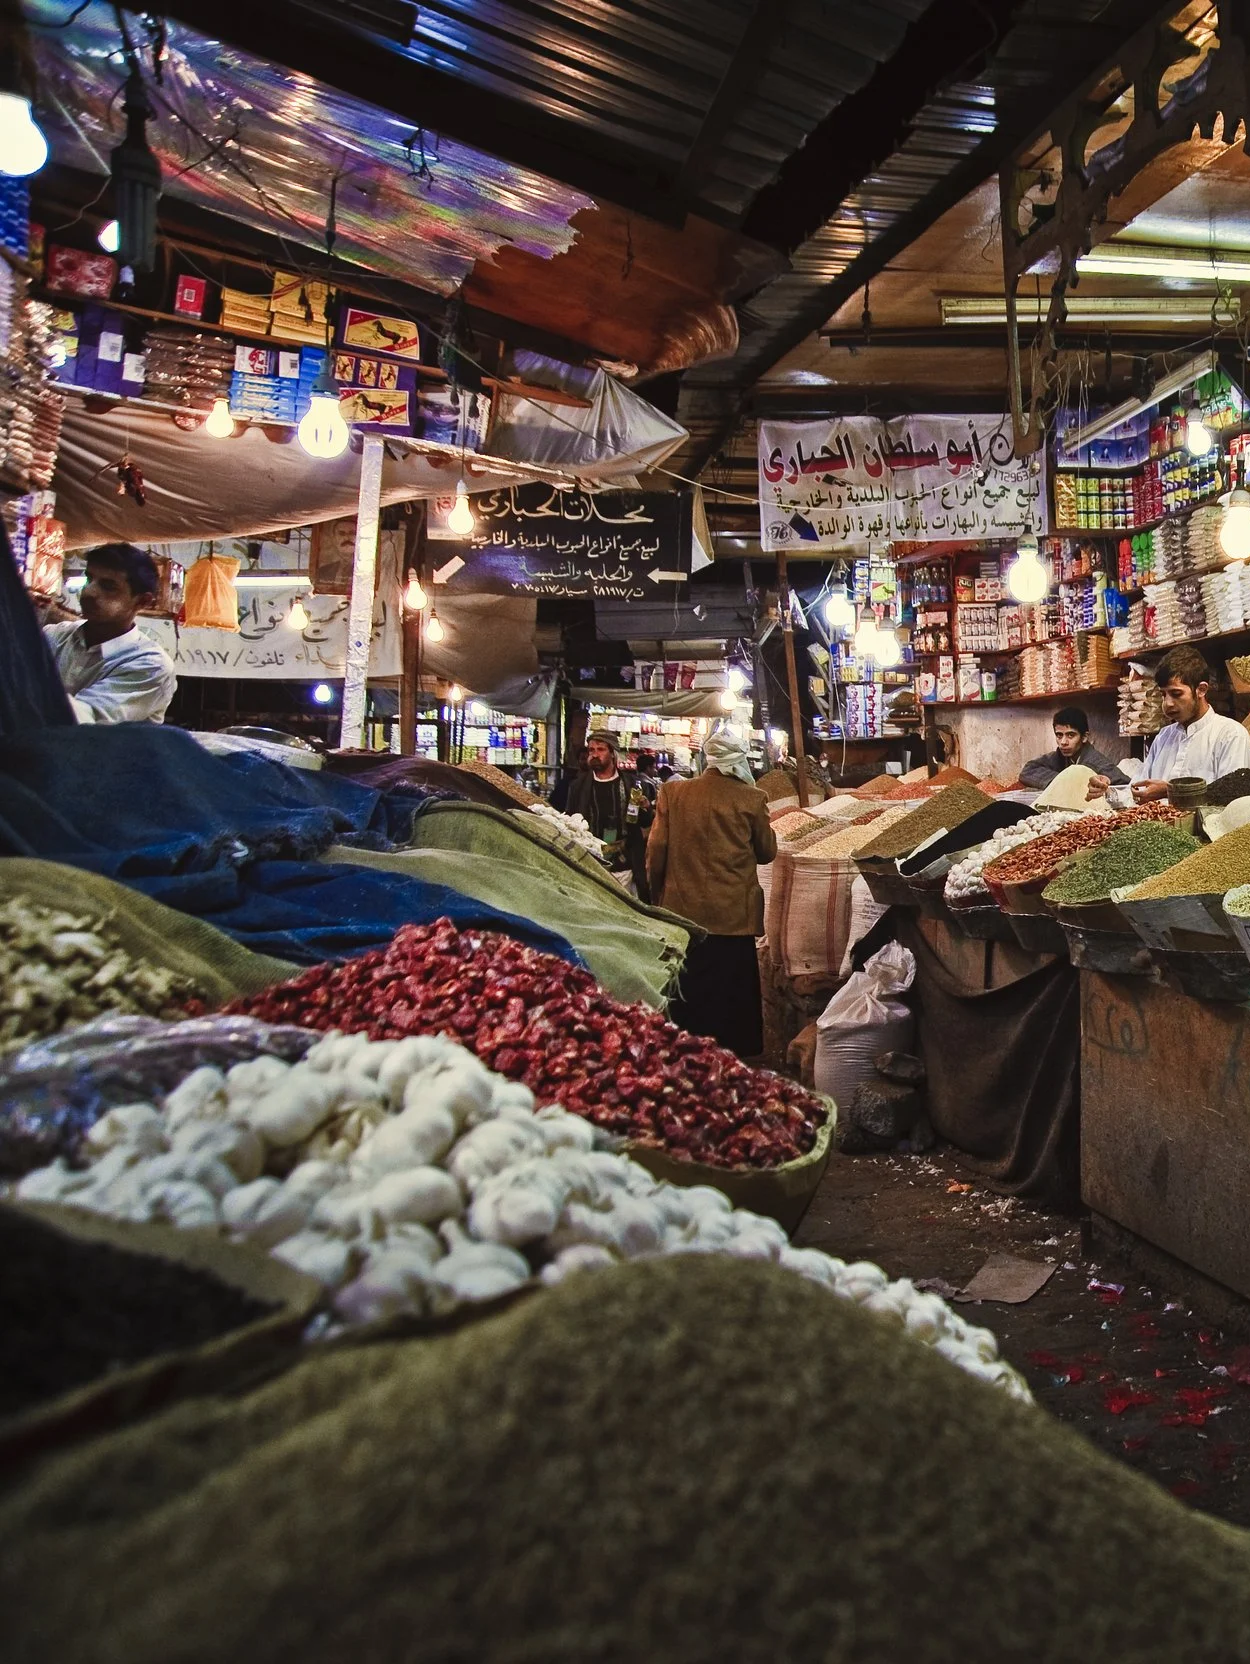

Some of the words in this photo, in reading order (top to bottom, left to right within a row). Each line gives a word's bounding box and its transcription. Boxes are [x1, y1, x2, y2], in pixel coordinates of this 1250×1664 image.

[863, 431, 940, 479] سلطان
[947, 420, 983, 476] أبو
[477, 486, 563, 522] الحباري
[847, 484, 890, 506] البلدية
[941, 480, 978, 510] أنواع
[983, 485, 1011, 508] جميع
[1016, 480, 1041, 508] لبيع
[564, 493, 655, 524] محلات
[818, 515, 856, 540] الوالدة
[858, 514, 891, 539] وقهوة
[895, 510, 928, 536] بأنواعها
[932, 511, 988, 535] والبهارات
[518, 531, 556, 549] البلدية
[556, 534, 590, 554] الحبوب
[619, 538, 642, 561] جميع
[640, 537, 660, 560] لبيع
